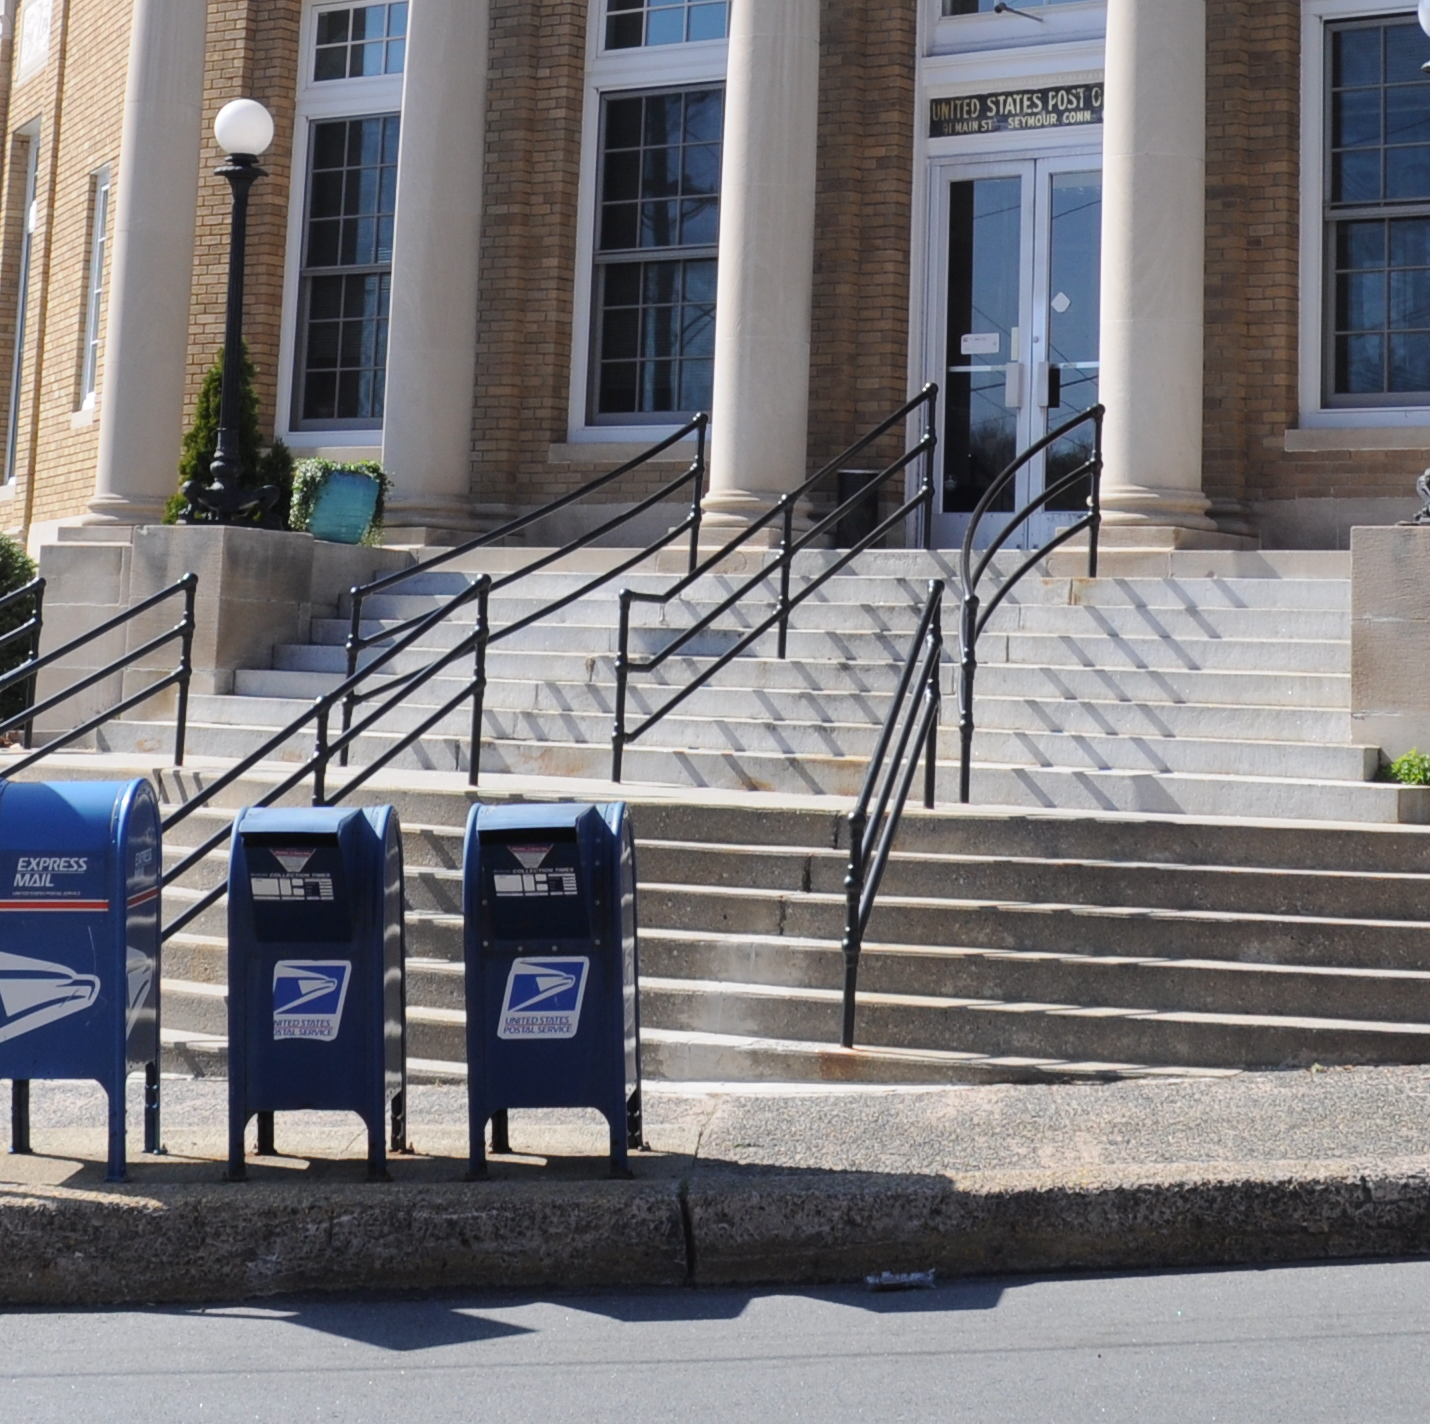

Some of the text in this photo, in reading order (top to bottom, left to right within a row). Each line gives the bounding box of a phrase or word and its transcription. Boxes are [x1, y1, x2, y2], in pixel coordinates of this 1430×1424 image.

[932, 98, 980, 121] UNITED
[986, 93, 1042, 117] STATES
[1048, 87, 1085, 112] POST
[955, 121, 978, 133] MAIN
[981, 119, 993, 132] ST
[1062, 110, 1091, 124] CONN
[17, 857, 88, 871] EXPRESS
[13, 873, 55, 887] MAIL
[301, 1019, 331, 1028] STATES
[505, 1016, 571, 1025] UNITED STATES
[298, 1028, 332, 1036] SERVICE
[503, 1026, 571, 1034] POSTAL SERVICE
